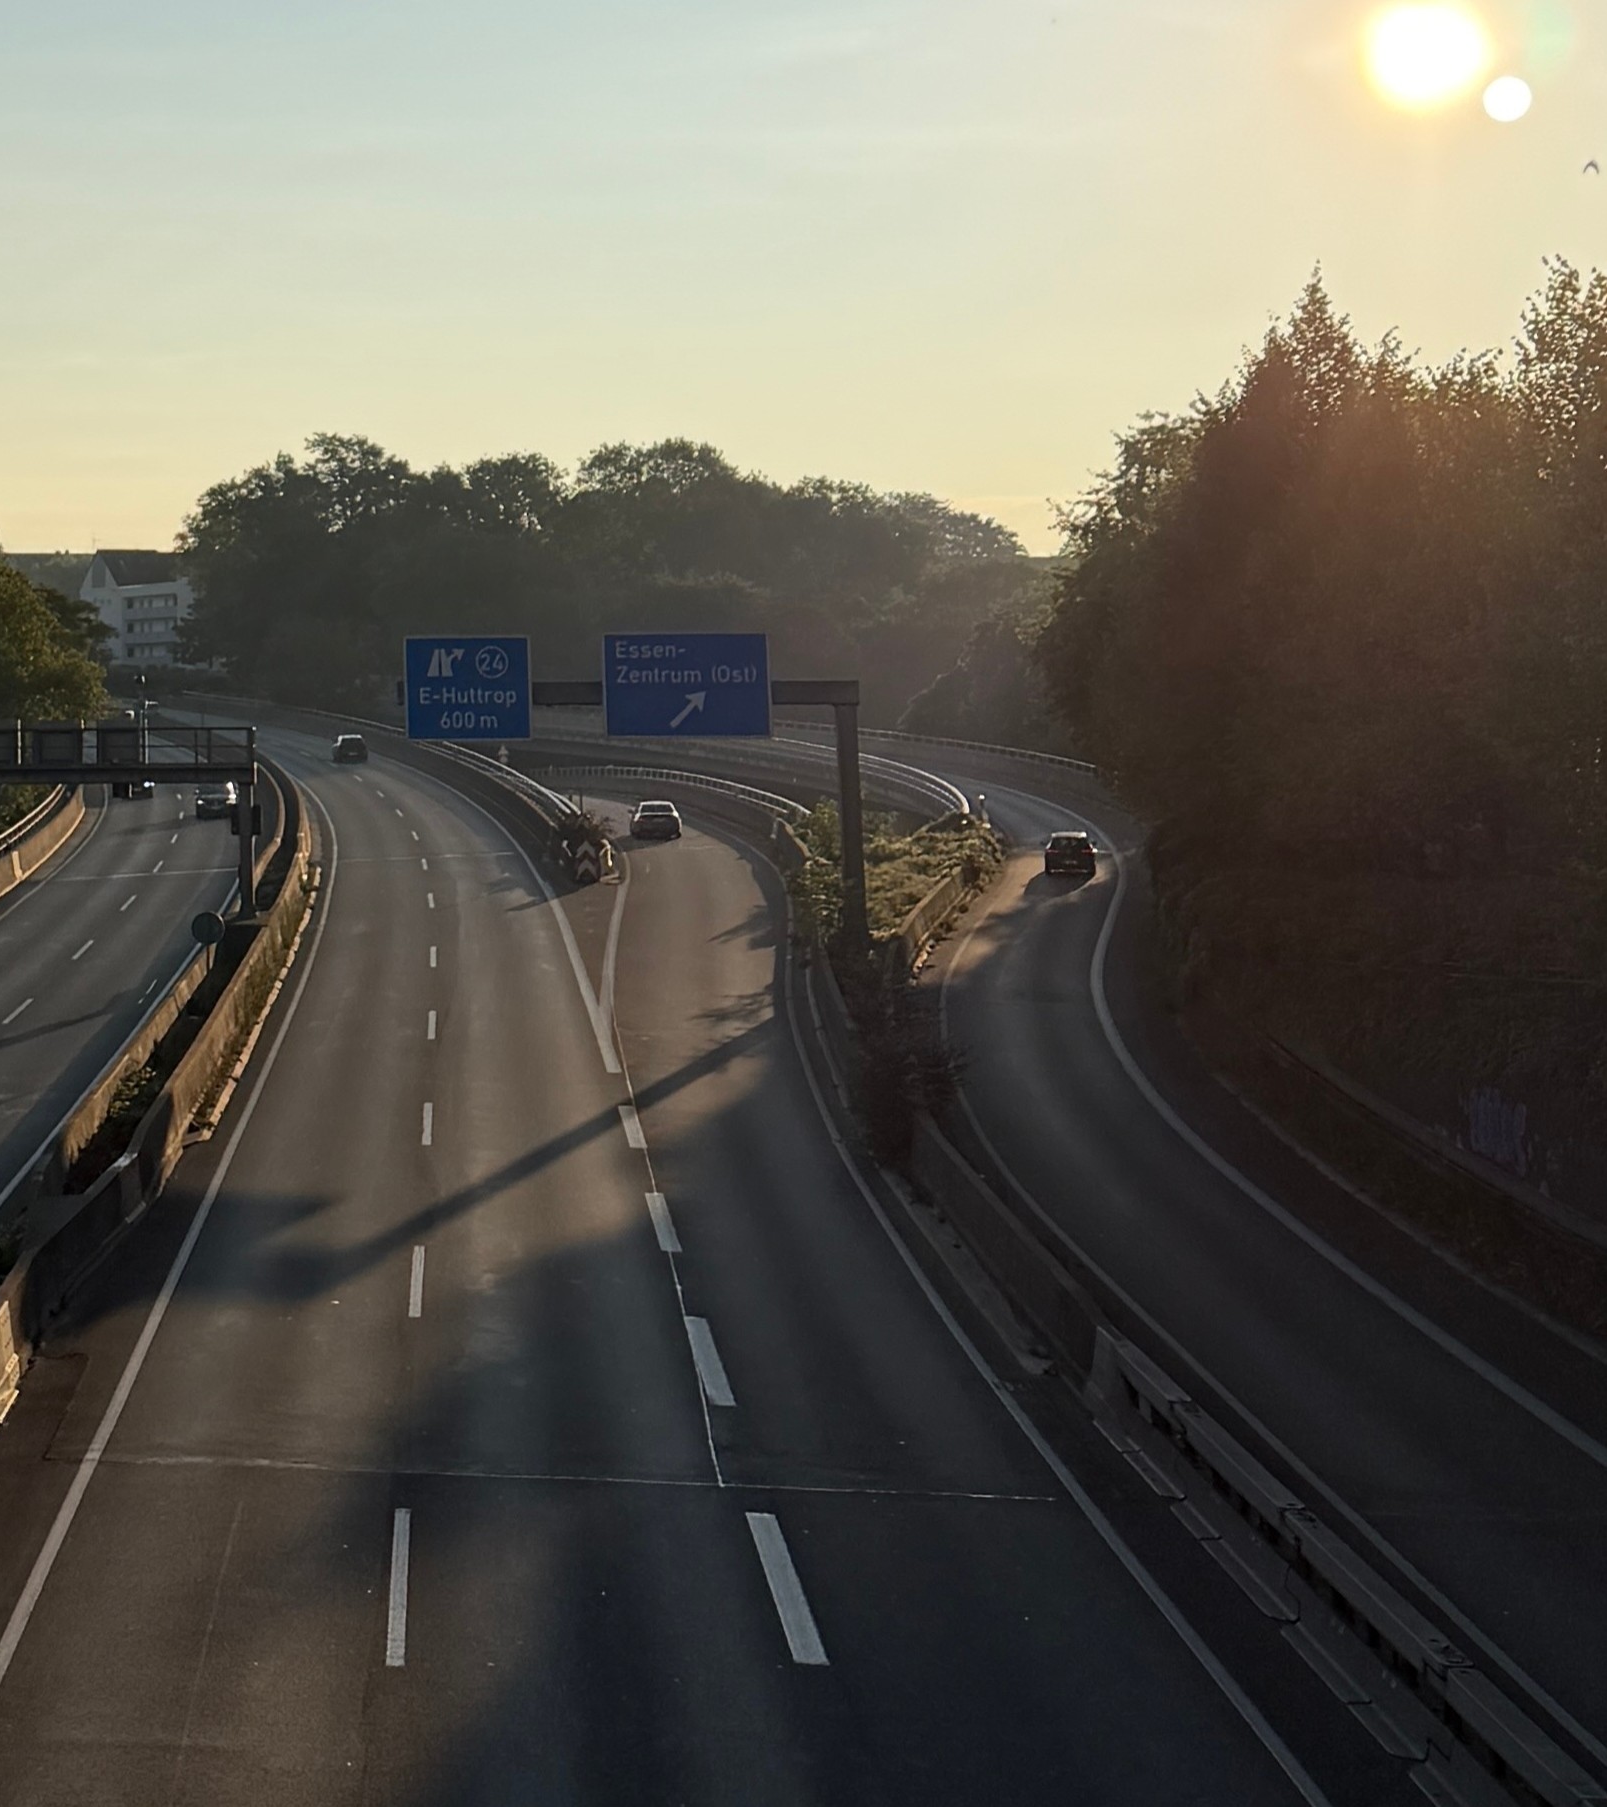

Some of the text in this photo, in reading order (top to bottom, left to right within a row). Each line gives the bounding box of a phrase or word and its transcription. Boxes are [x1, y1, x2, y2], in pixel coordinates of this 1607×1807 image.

[615, 641, 686, 659] Essen-
[480, 654, 504, 672] 24
[615, 665, 758, 684] Zentrum (Ost)
[419, 687, 517, 708] E-Huttrop
[440, 711, 499, 730] 600 m
